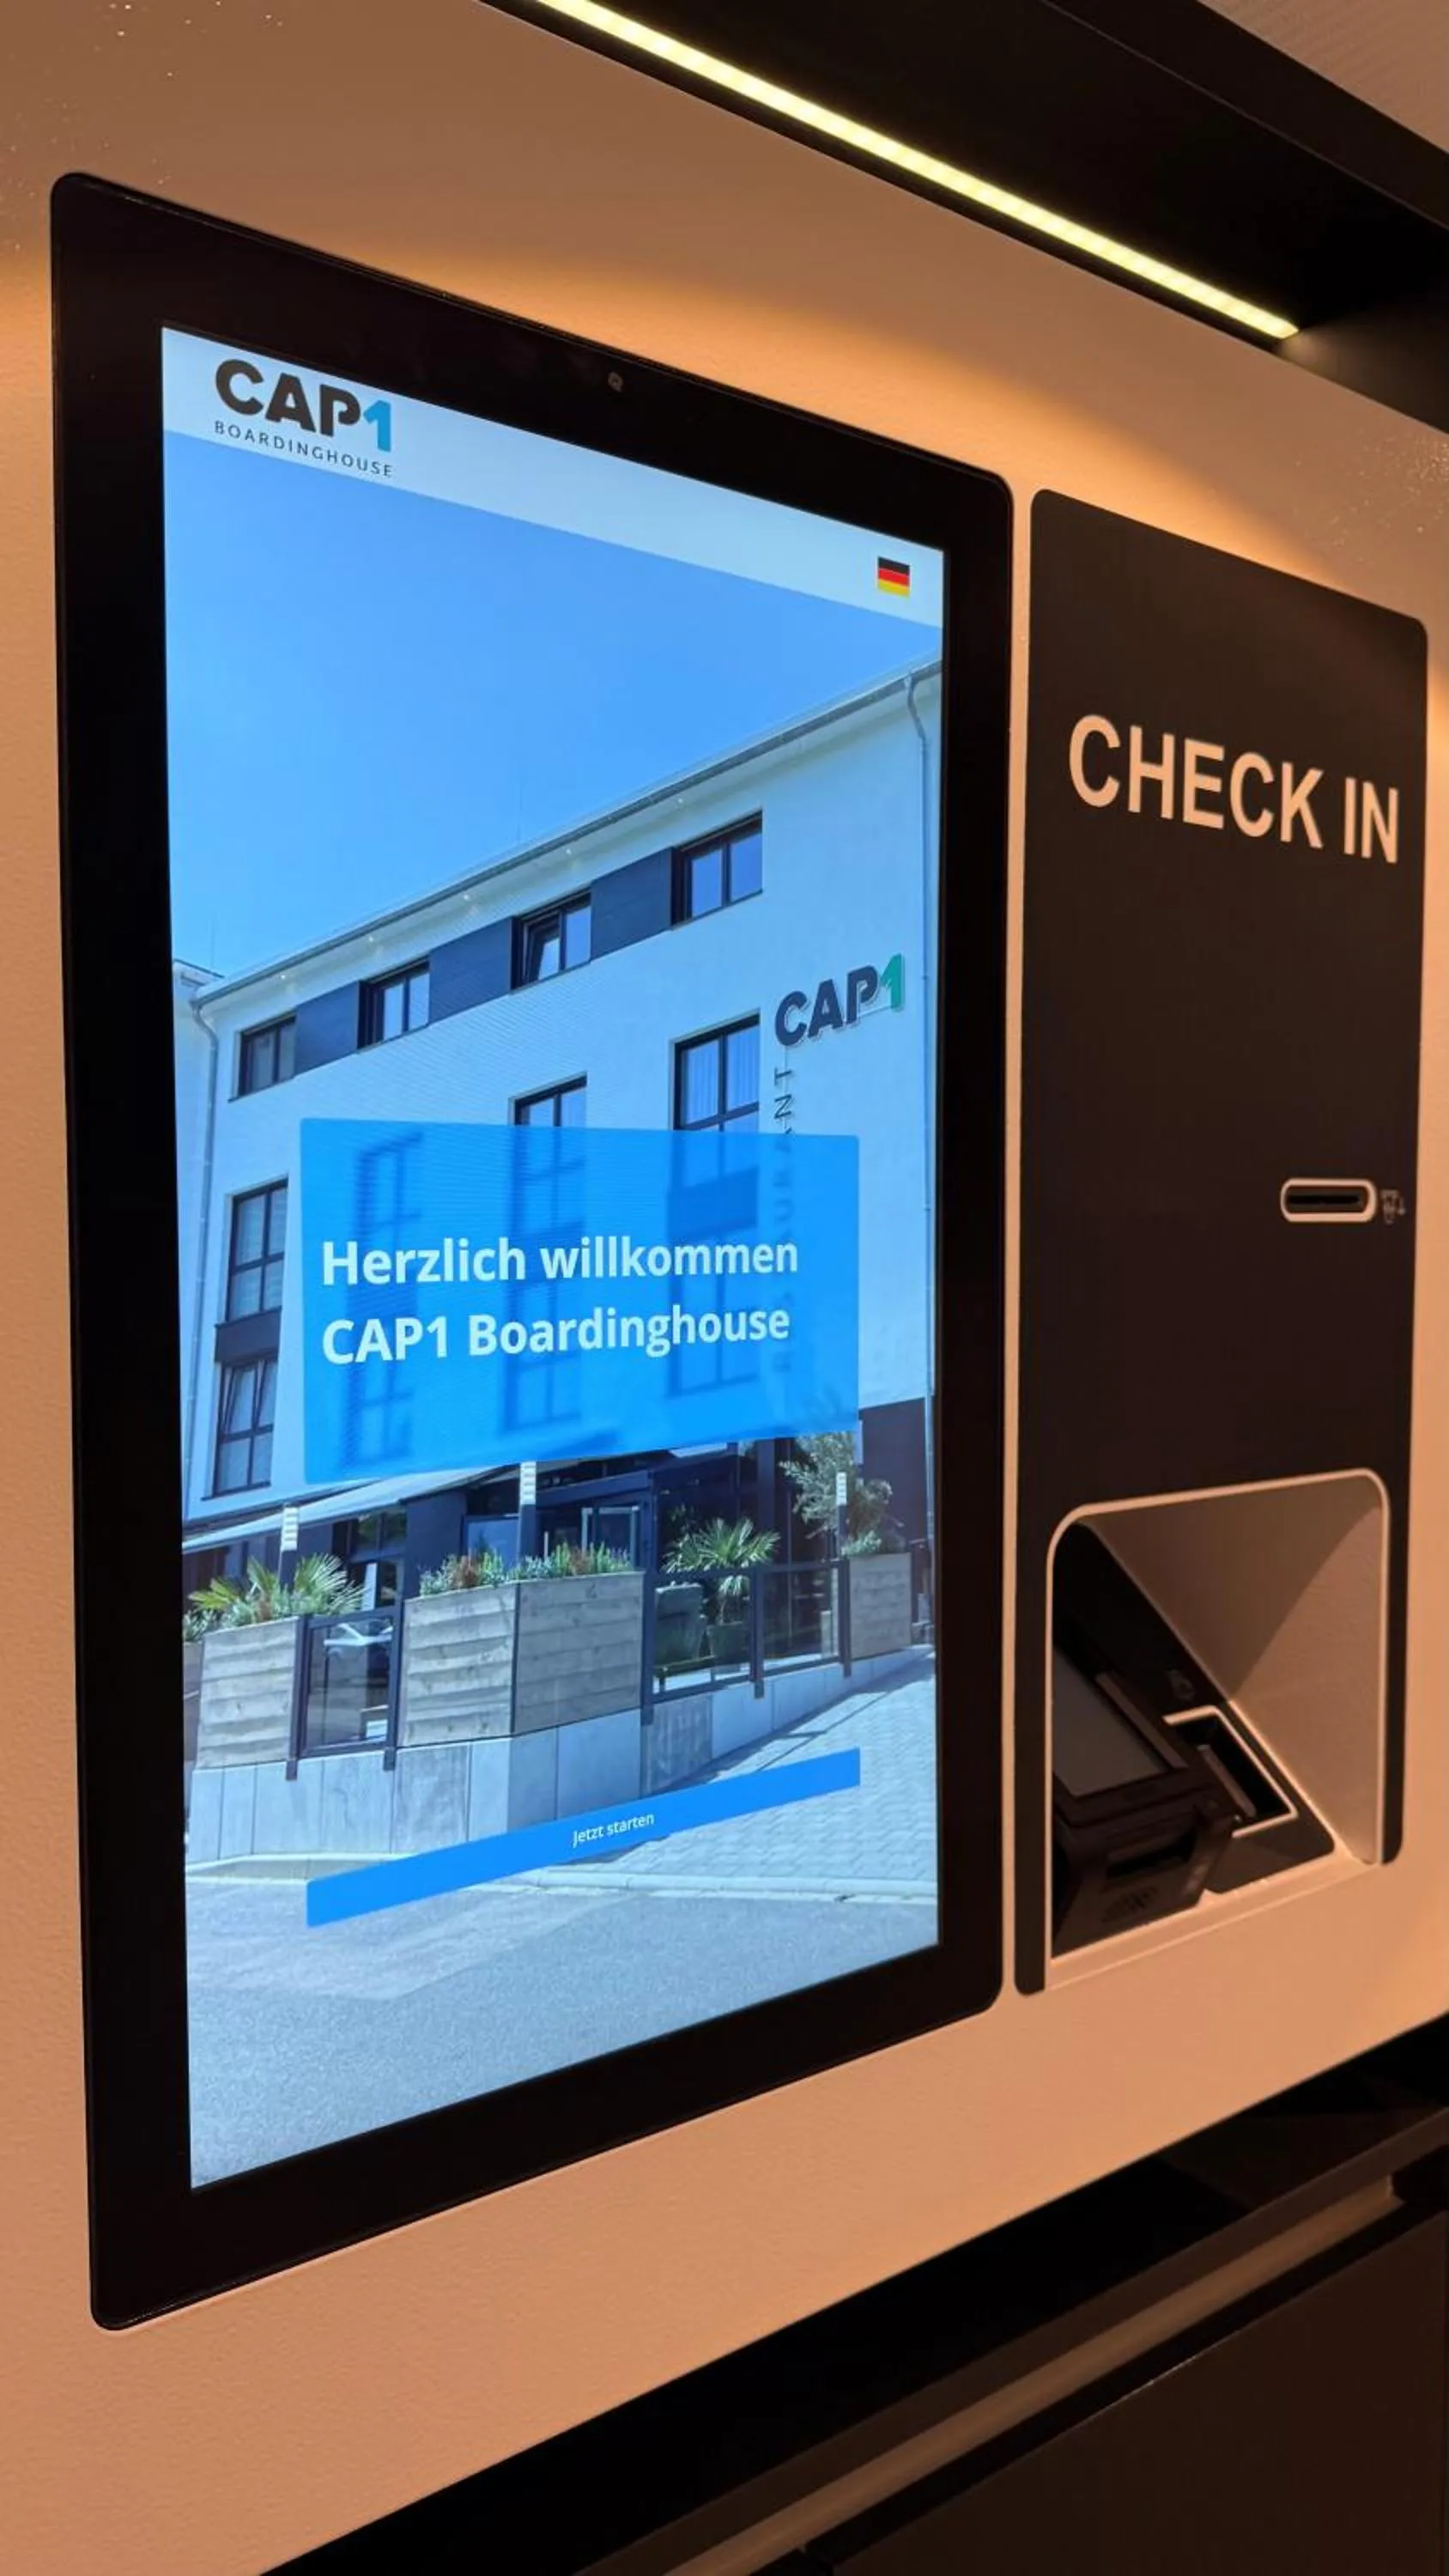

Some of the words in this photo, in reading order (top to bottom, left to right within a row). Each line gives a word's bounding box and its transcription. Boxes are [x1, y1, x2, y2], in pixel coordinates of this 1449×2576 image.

[215, 359, 392, 453] CAP1
[214, 420, 392, 478] BOARDINGHOUSE
[1069, 714, 1323, 849] CHECK
[1343, 776, 1399, 864] IN
[774, 952, 906, 1047] CAP1
[322, 1237, 526, 1286] Herzlich
[540, 1236, 799, 1279] willkommen
[322, 1315, 448, 1364] CAP1
[469, 1303, 790, 1358] Boardinghouse
[572, 1826, 603, 1848] Jetzt
[606, 1813, 655, 1836] starten
